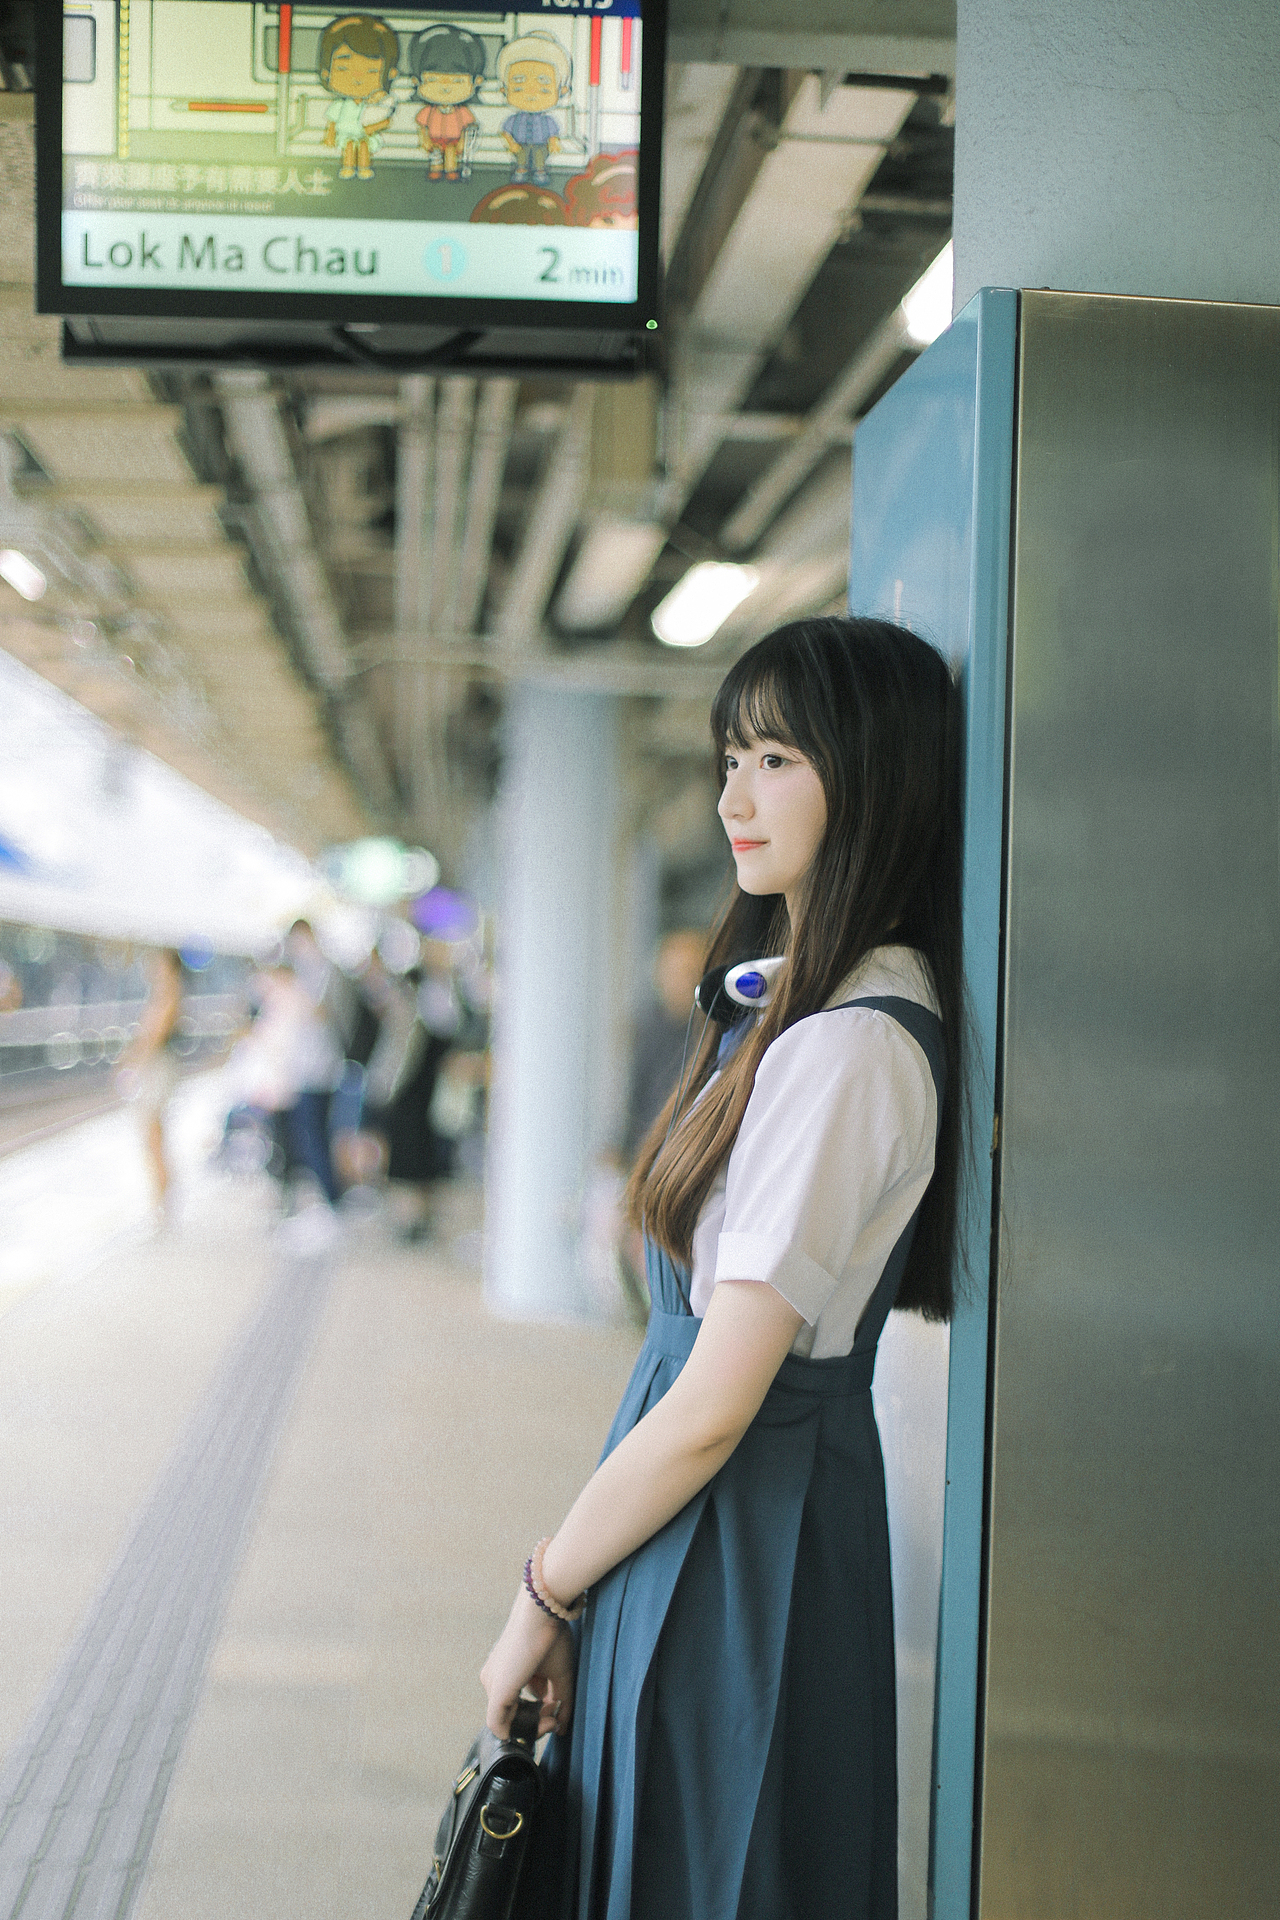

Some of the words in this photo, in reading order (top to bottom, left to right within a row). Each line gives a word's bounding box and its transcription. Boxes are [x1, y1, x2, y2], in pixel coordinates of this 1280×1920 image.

[83, 232, 162, 270] Lok
[178, 235, 245, 272] Ma
[263, 235, 377, 276] Chau
[438, 243, 453, 276] 1
[539, 246, 560, 283] 2
[569, 262, 625, 286] min
